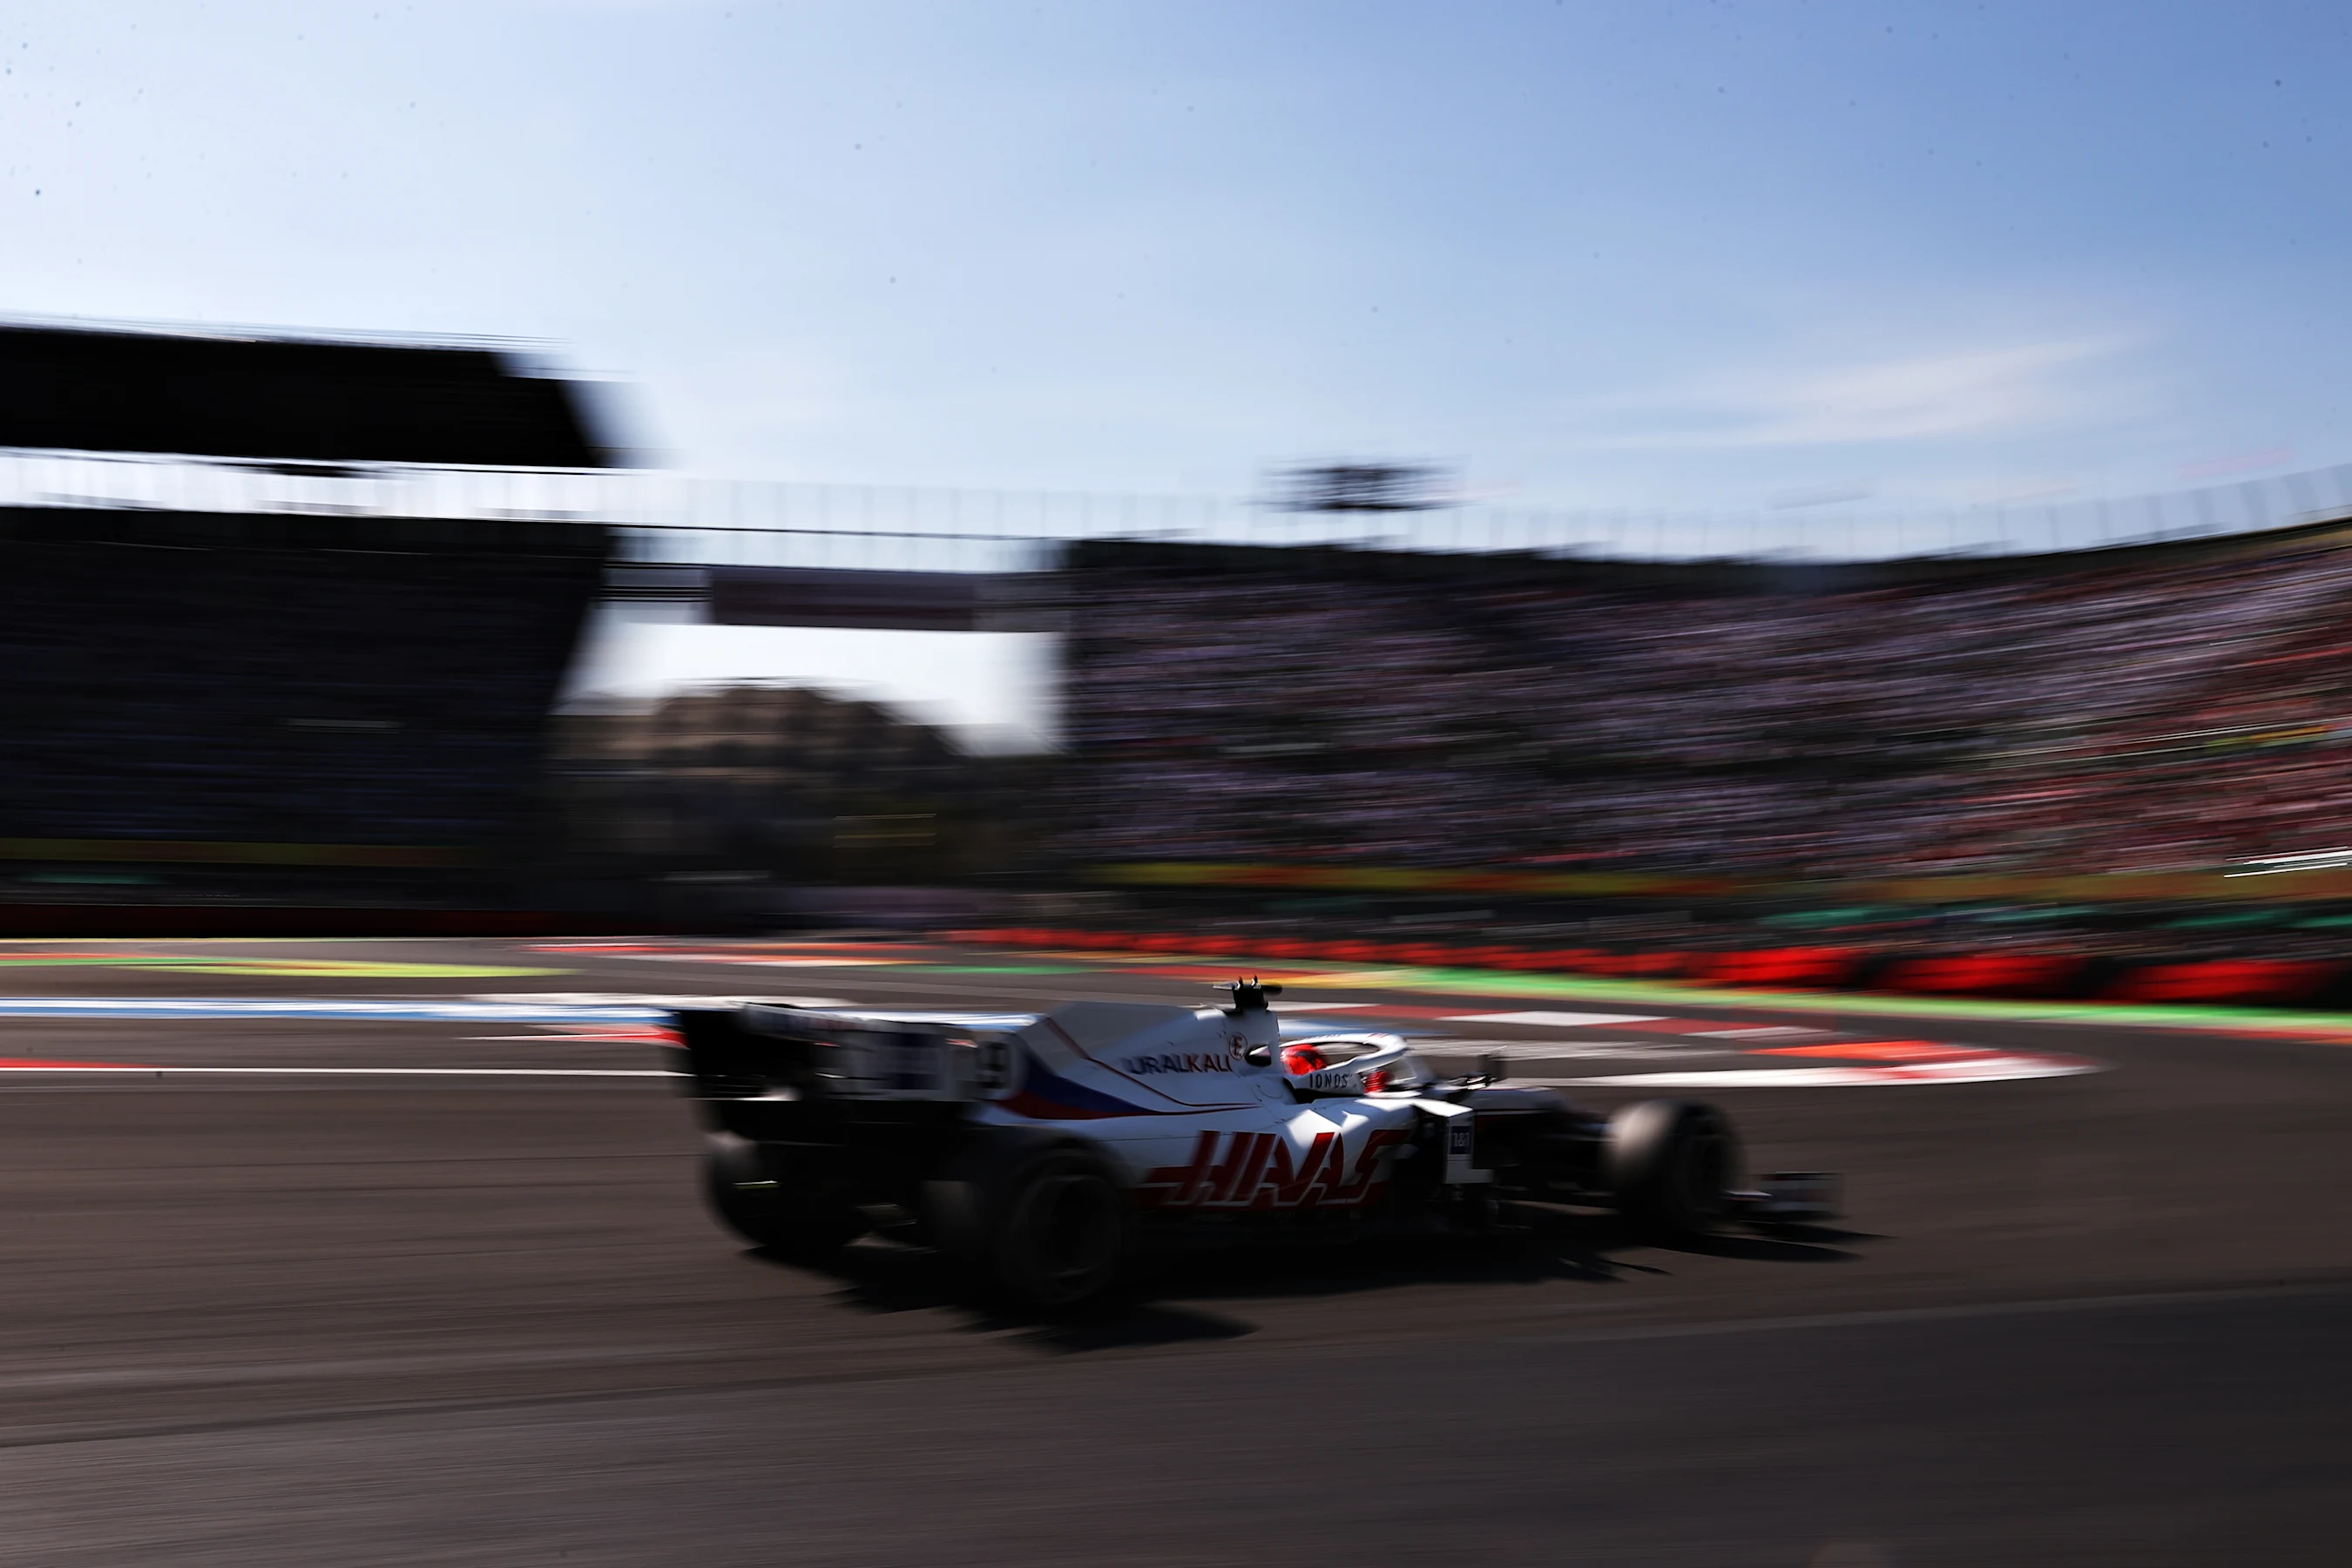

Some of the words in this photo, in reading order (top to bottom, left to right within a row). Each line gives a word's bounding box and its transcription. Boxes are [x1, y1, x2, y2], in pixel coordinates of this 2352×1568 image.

[1122, 1053, 1233, 1074] URALKALI
[1309, 1072, 1348, 1089] IONOS
[1135, 1129, 1412, 1211] HAAS
